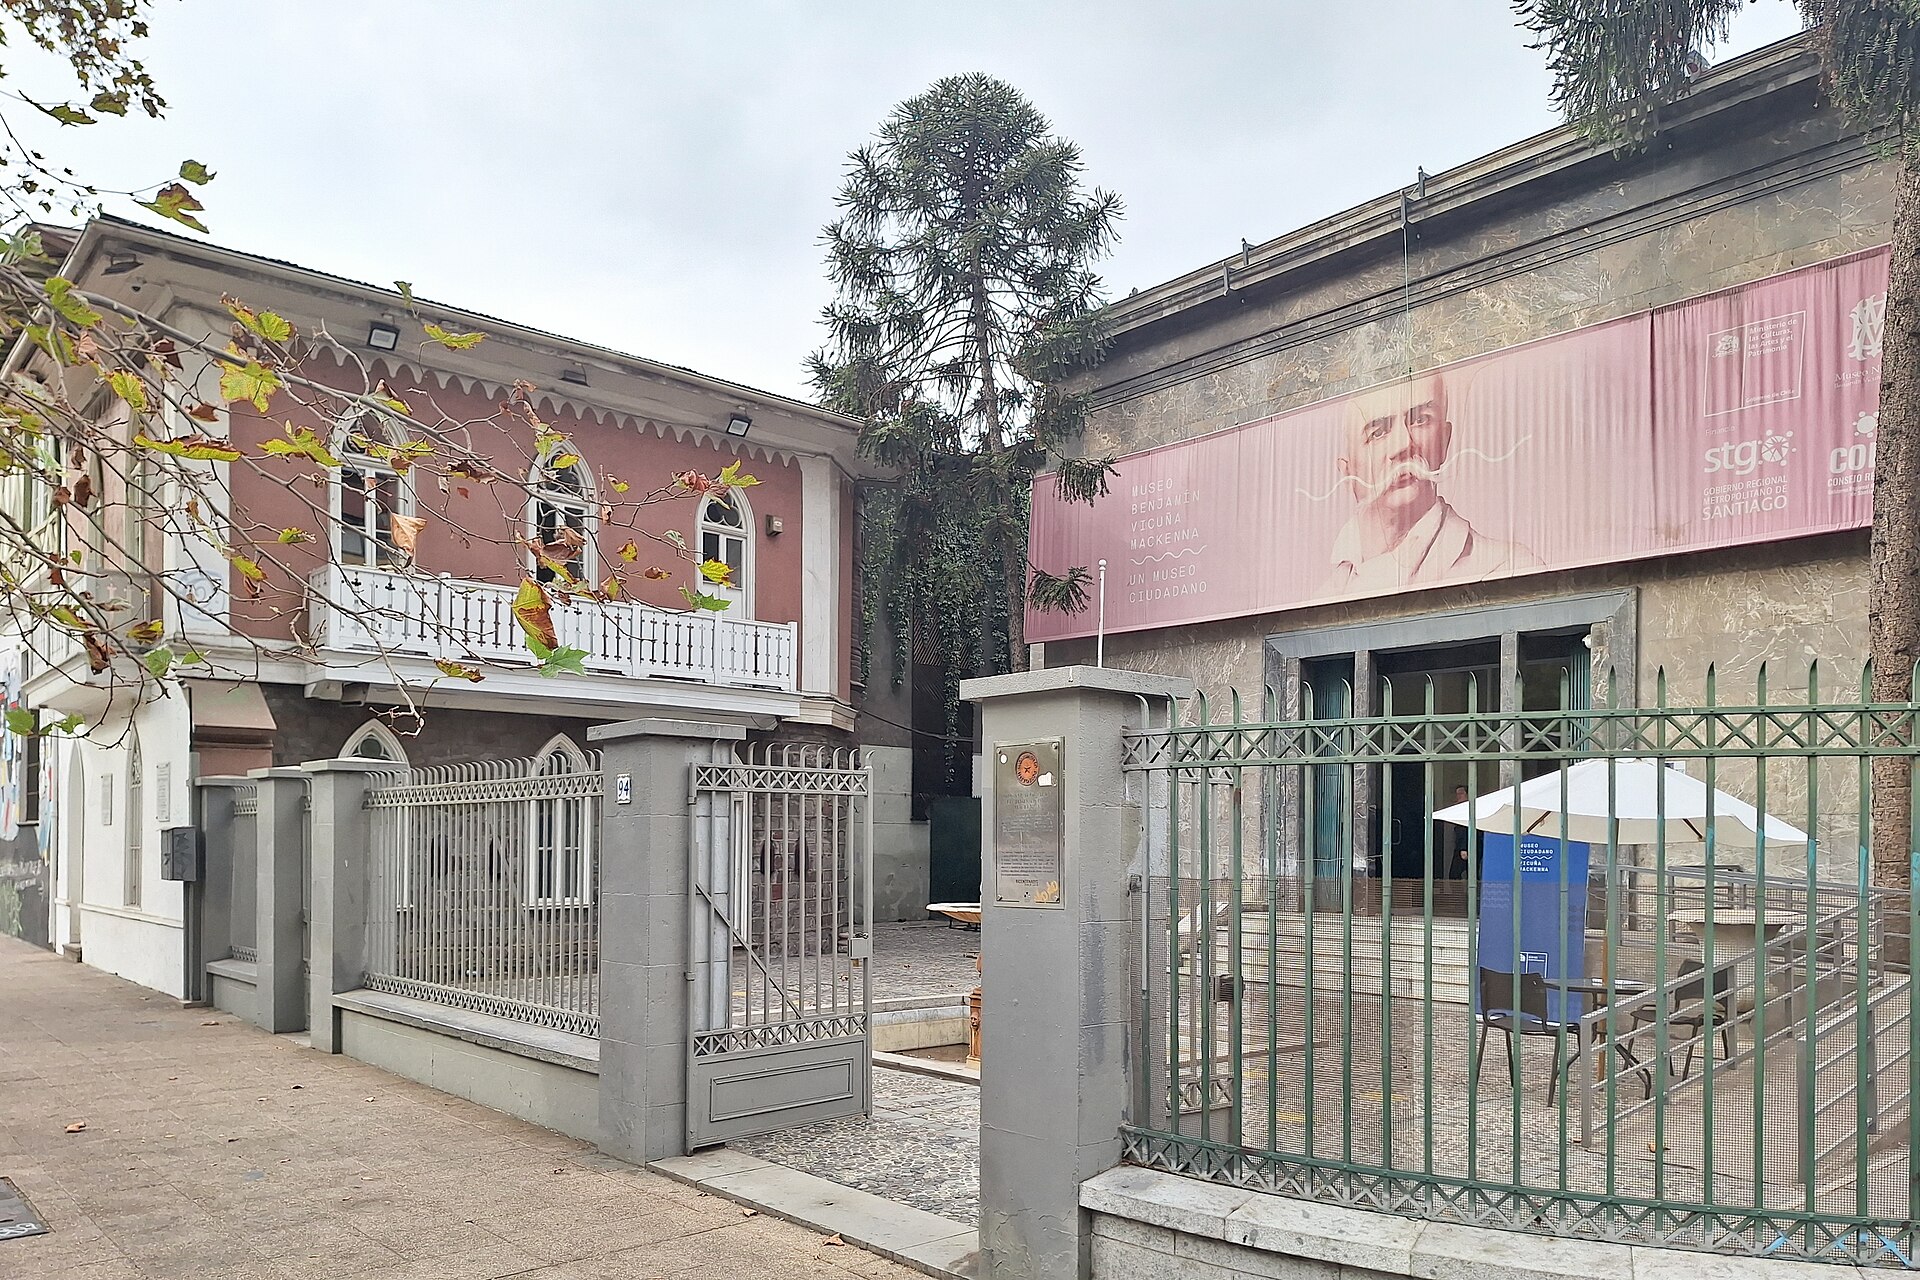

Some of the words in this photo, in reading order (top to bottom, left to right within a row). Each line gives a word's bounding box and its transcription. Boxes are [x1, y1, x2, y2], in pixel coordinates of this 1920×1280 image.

[1131, 477, 1173, 497] MUSEO
[1703, 481, 1744, 496] GOBIERNO
[1746, 475, 1787, 489] REGIONAL
[1827, 474, 1862, 488] CONSEJO
[1131, 489, 1200, 515] BENJAMÍN
[1702, 487, 1773, 505] METROPOLITANO
[1775, 484, 1787, 494] DE
[1702, 495, 1787, 521] SANTIAGO
[1131, 511, 1182, 532] VICUÑA
[1130, 527, 1199, 550] MACKENNA
[1129, 572, 1145, 586] UN
[1152, 564, 1196, 582] MUSEO
[1129, 581, 1207, 603] CIUDADANO
[618, 780, 630, 797] 94
